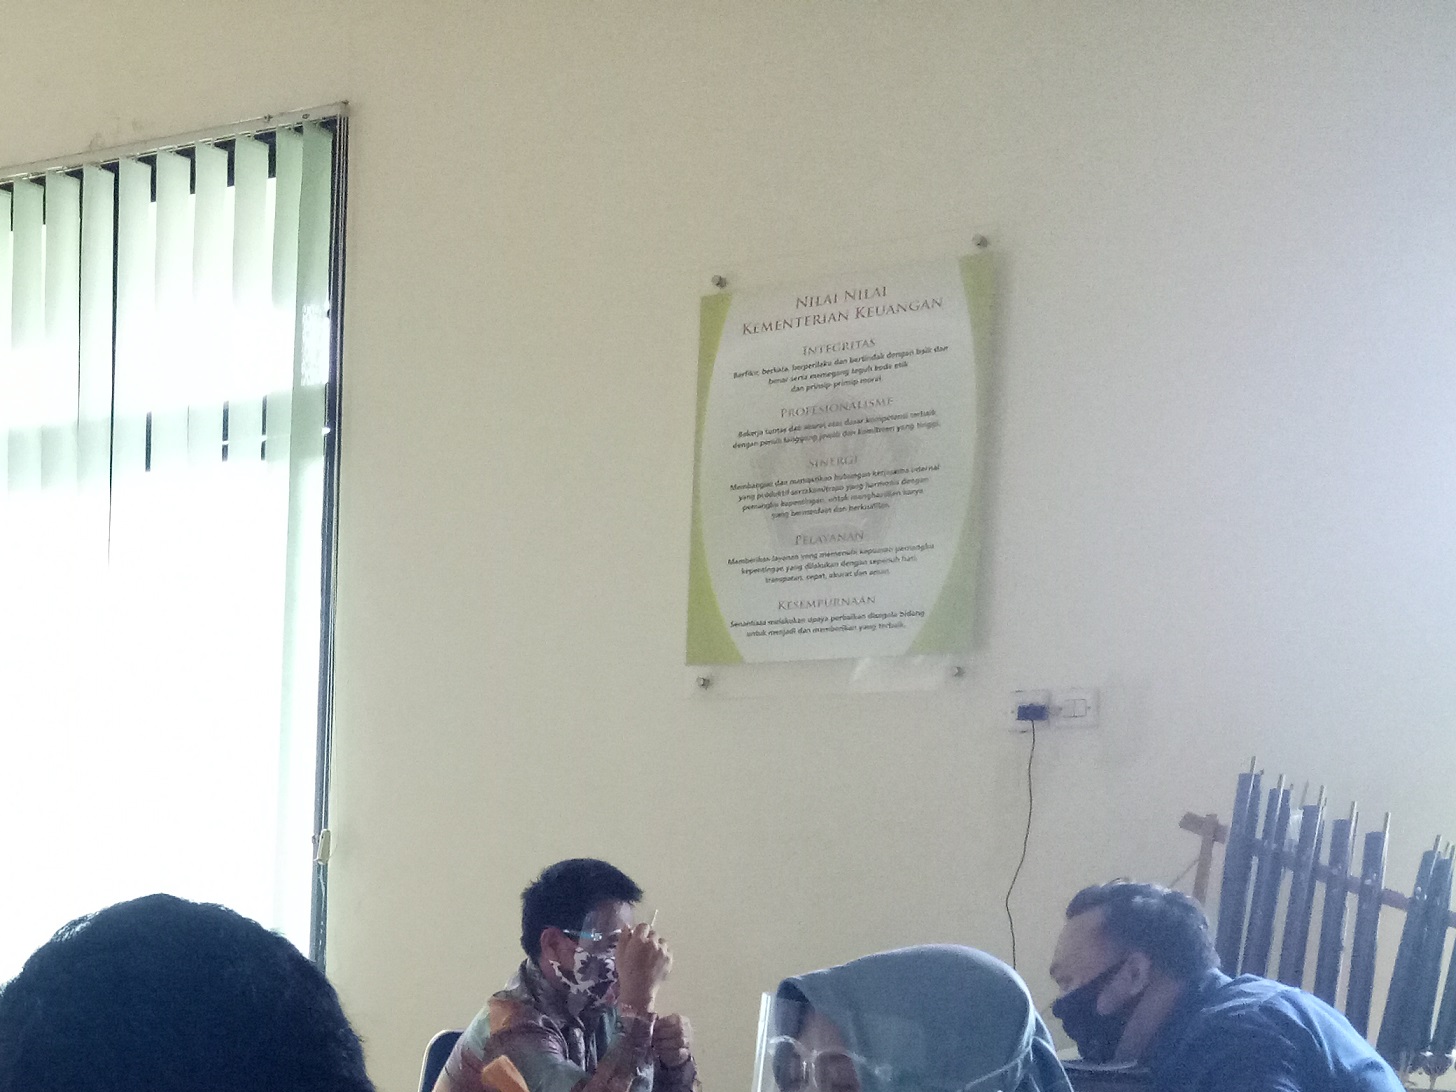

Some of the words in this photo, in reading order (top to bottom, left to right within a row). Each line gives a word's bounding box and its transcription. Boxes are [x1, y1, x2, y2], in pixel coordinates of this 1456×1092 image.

[796, 294, 839, 309] NILAI
[844, 286, 887, 302] NILAI
[743, 310, 849, 335] KEMENTERIAN
[855, 297, 943, 319] KEUANGAN
[802, 339, 875, 356] INTEGRITAS
[780, 398, 894, 418] PROFESIONALISME
[794, 532, 864, 546] PELAYANAN
[778, 595, 876, 611] KESEMPURNAAN
